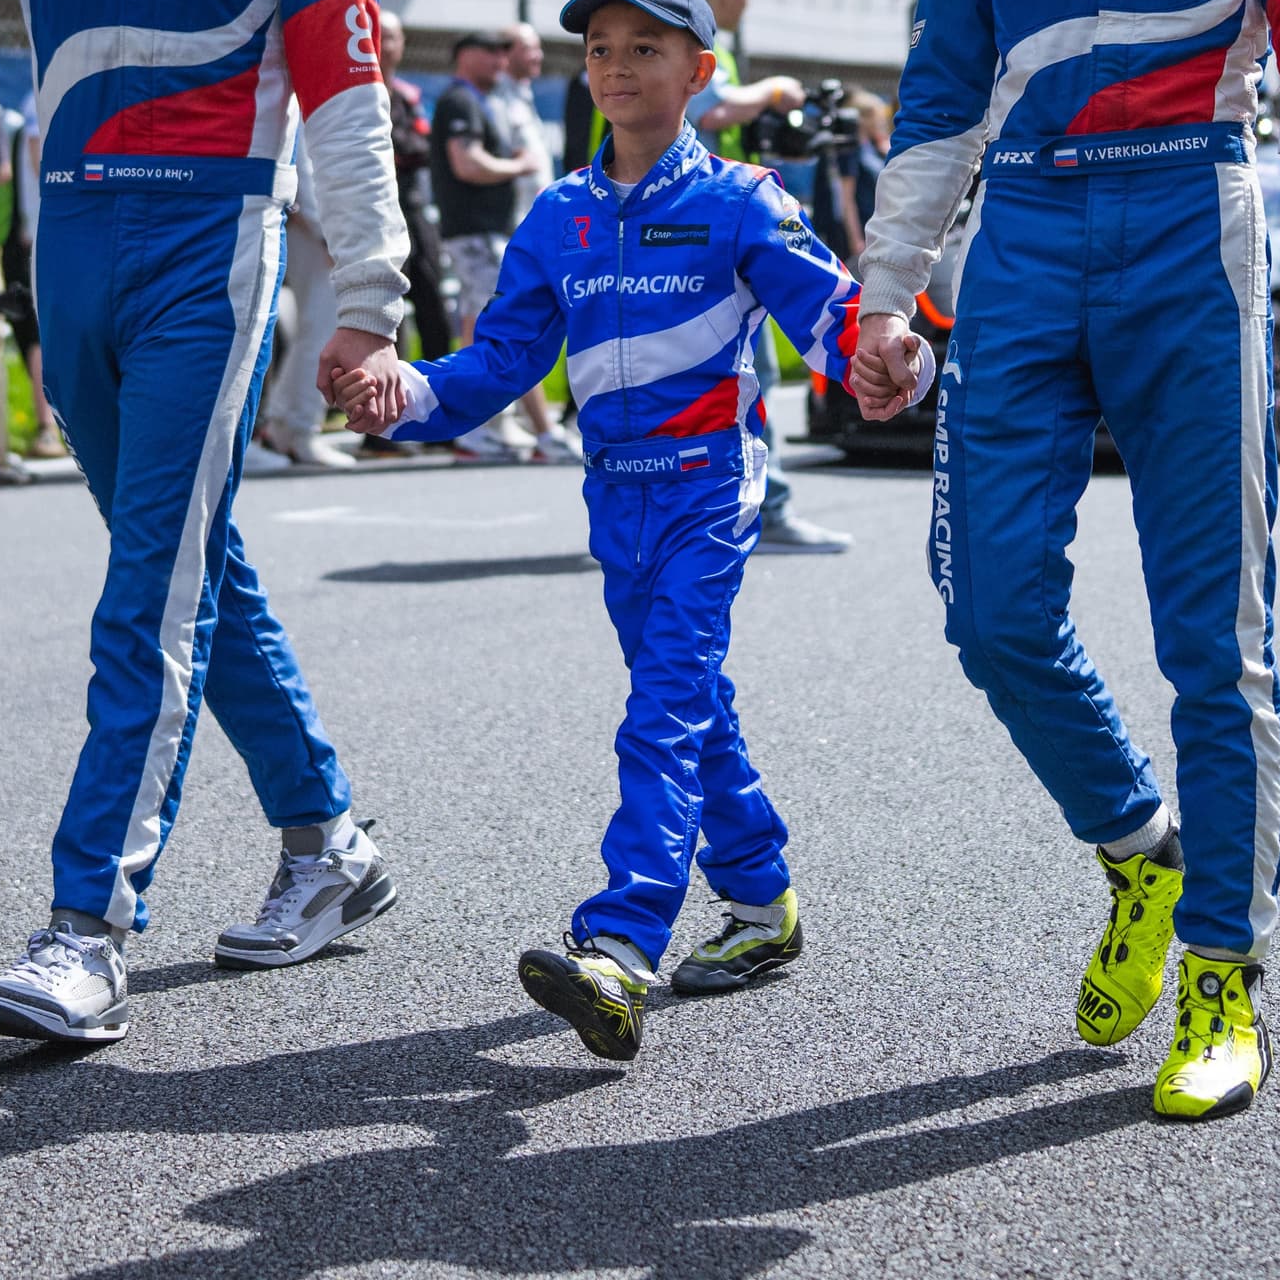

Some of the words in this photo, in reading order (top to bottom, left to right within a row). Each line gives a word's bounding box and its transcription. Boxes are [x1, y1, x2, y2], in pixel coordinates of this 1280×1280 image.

[993, 151, 1036, 165] HRX
[1084, 136, 1209, 161] V.VERKHOLANTSEV
[45, 170, 75, 184] HRX
[652, 231, 672, 239] SMP
[573, 274, 614, 300] SMP
[616, 274, 705, 295] RACING
[934, 388, 949, 465] SMP
[603, 455, 676, 473] E.AVDZHY
[934, 469, 955, 606] RACING
